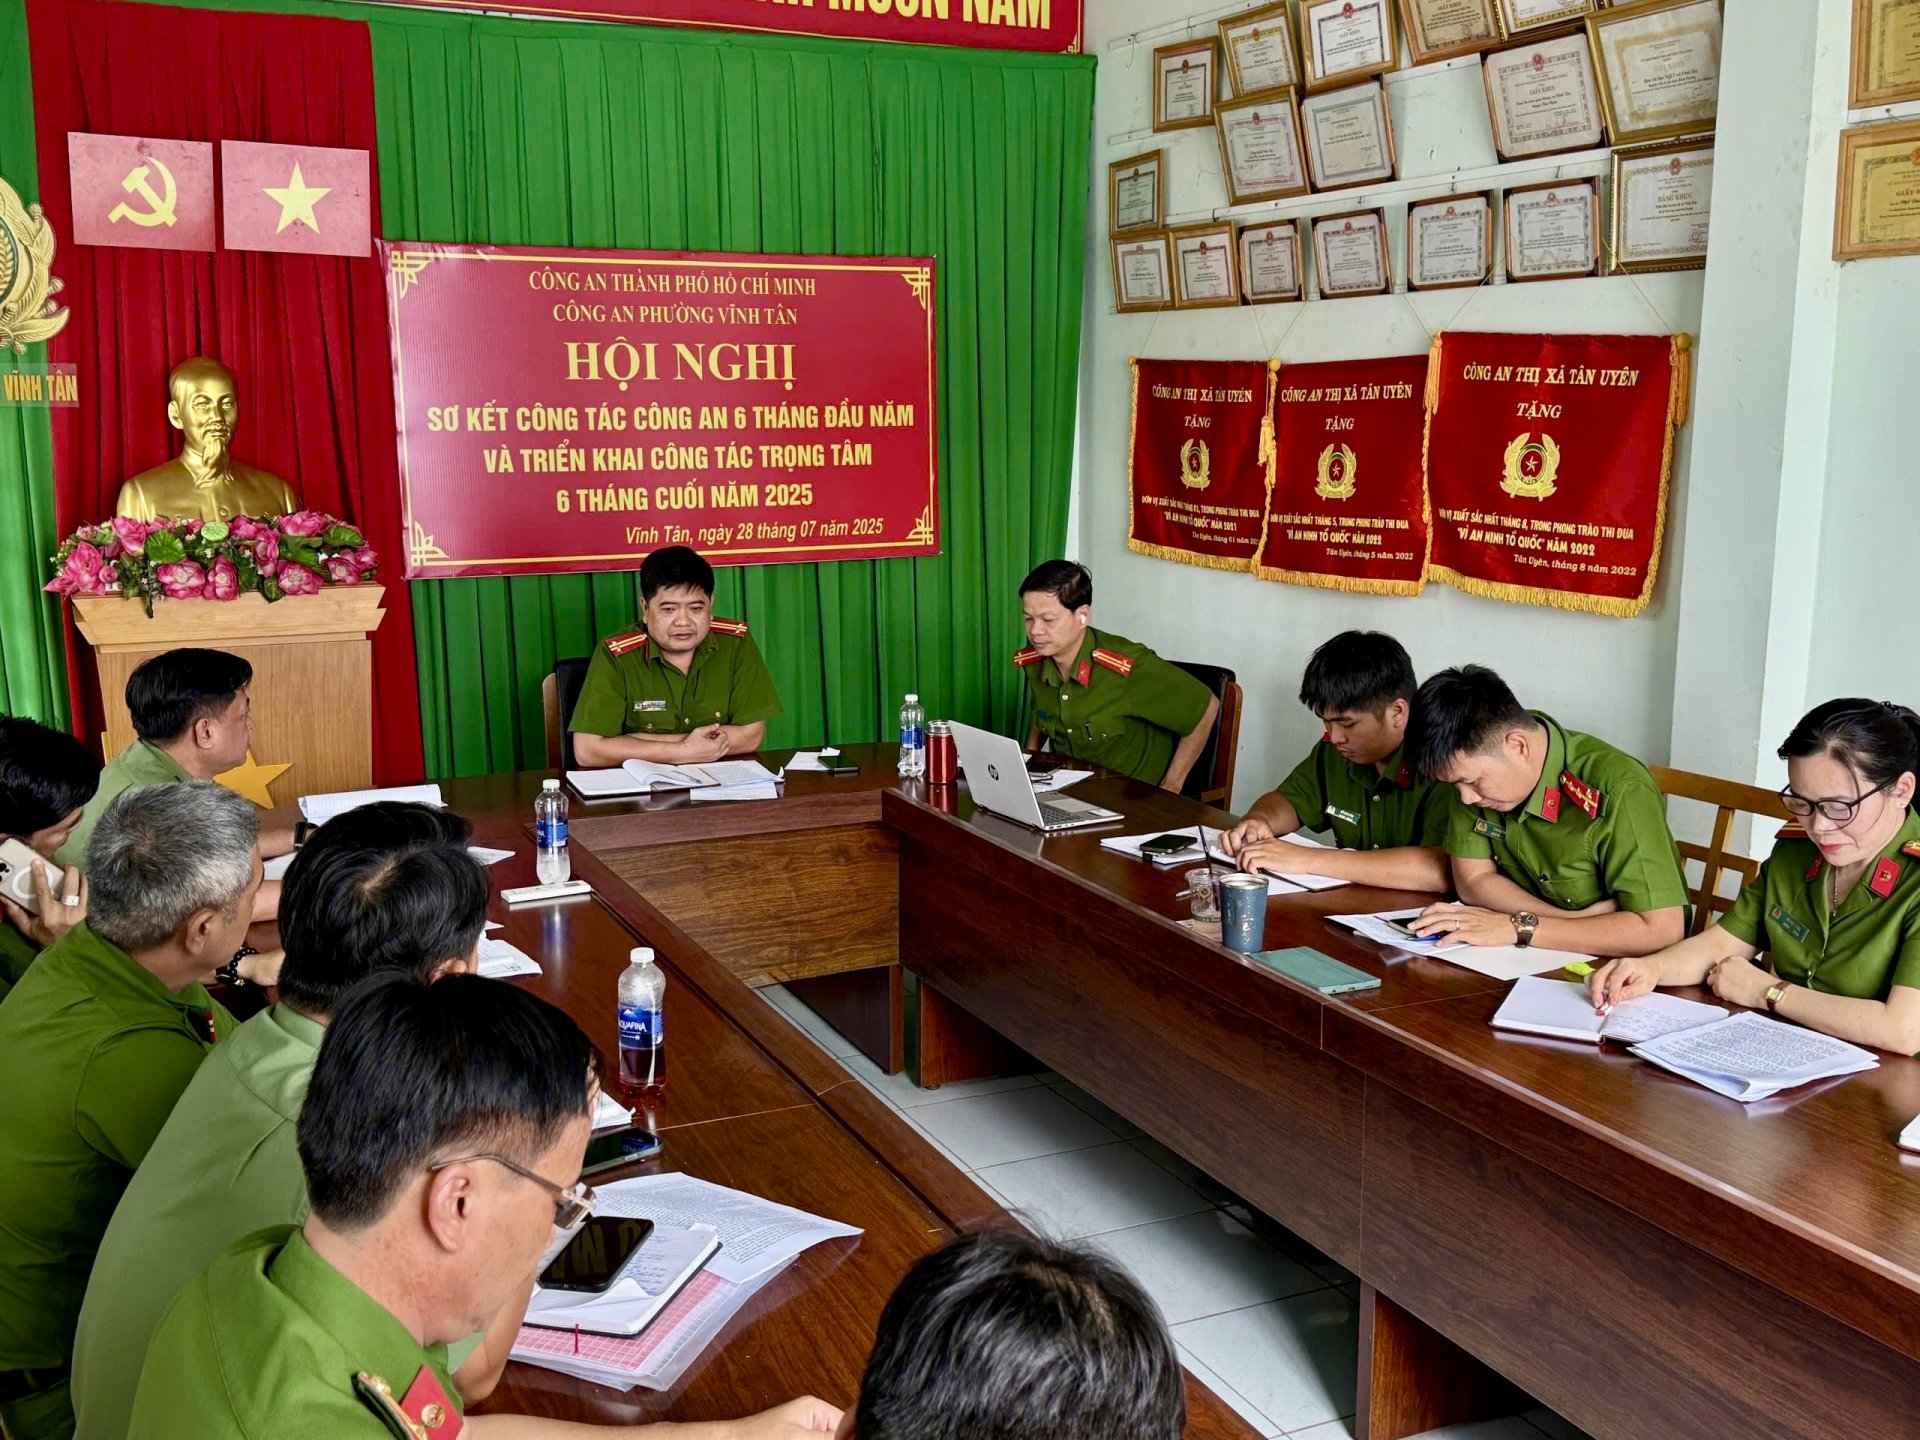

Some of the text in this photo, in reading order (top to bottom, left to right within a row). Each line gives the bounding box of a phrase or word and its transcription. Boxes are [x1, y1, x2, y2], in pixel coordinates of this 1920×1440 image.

[529, 265, 816, 296] CÔNG AN THÀNH PHỐ HỒ CHÍ MINH
[553, 299, 797, 325] CÔNG AN PHƯỜNG VĨNH TÂN
[563, 336, 797, 391] HỘI NGHỊ
[1463, 361, 1492, 380] CÔNG
[1493, 366, 1513, 382] AN
[1515, 367, 1541, 387] THỊ
[1569, 365, 1596, 385] TÂN
[1599, 366, 1640, 387] UYÊN
[3, 369, 79, 401] VĨNH TÂN
[1281, 386, 1307, 402] CÔNG
[1307, 389, 1323, 402] AN
[1324, 388, 1342, 404] THỊ
[1360, 383, 1380, 400] TÂN
[1383, 381, 1413, 400] UYÊN
[427, 397, 914, 433] SƠ KẾT CÔNG TÁC CÔNG AN 6 THÁNG ĐẦU NĂM
[1184, 414, 1211, 428] TẶNG
[1516, 400, 1563, 420] TẶNG
[1325, 416, 1354, 432] TẶNG
[483, 438, 872, 473] VÀ TRIỂN KHAI CÔNG TÁC TRỌNG TÂM
[556, 480, 813, 513] 6 THÁNG CUỐI NĂM 2025
[626, 518, 883, 546] Vĩnh Tân, ngày 28 tháng 07 năm 2025
[1530, 519, 1552, 533] TRONG
[1552, 522, 1576, 536] PHONG
[1601, 526, 1616, 539] THI
[1616, 527, 1634, 540] ĐUA
[1469, 529, 1484, 542] AN
[1546, 537, 1568, 554] NĂM
[1570, 542, 1595, 557] 2022
[1395, 552, 1413, 561] 2022
[1551, 560, 1578, 572] tháng
[1579, 563, 1586, 572] 8
[1587, 564, 1609, 574] năm
[1610, 566, 1637, 576] 2022
